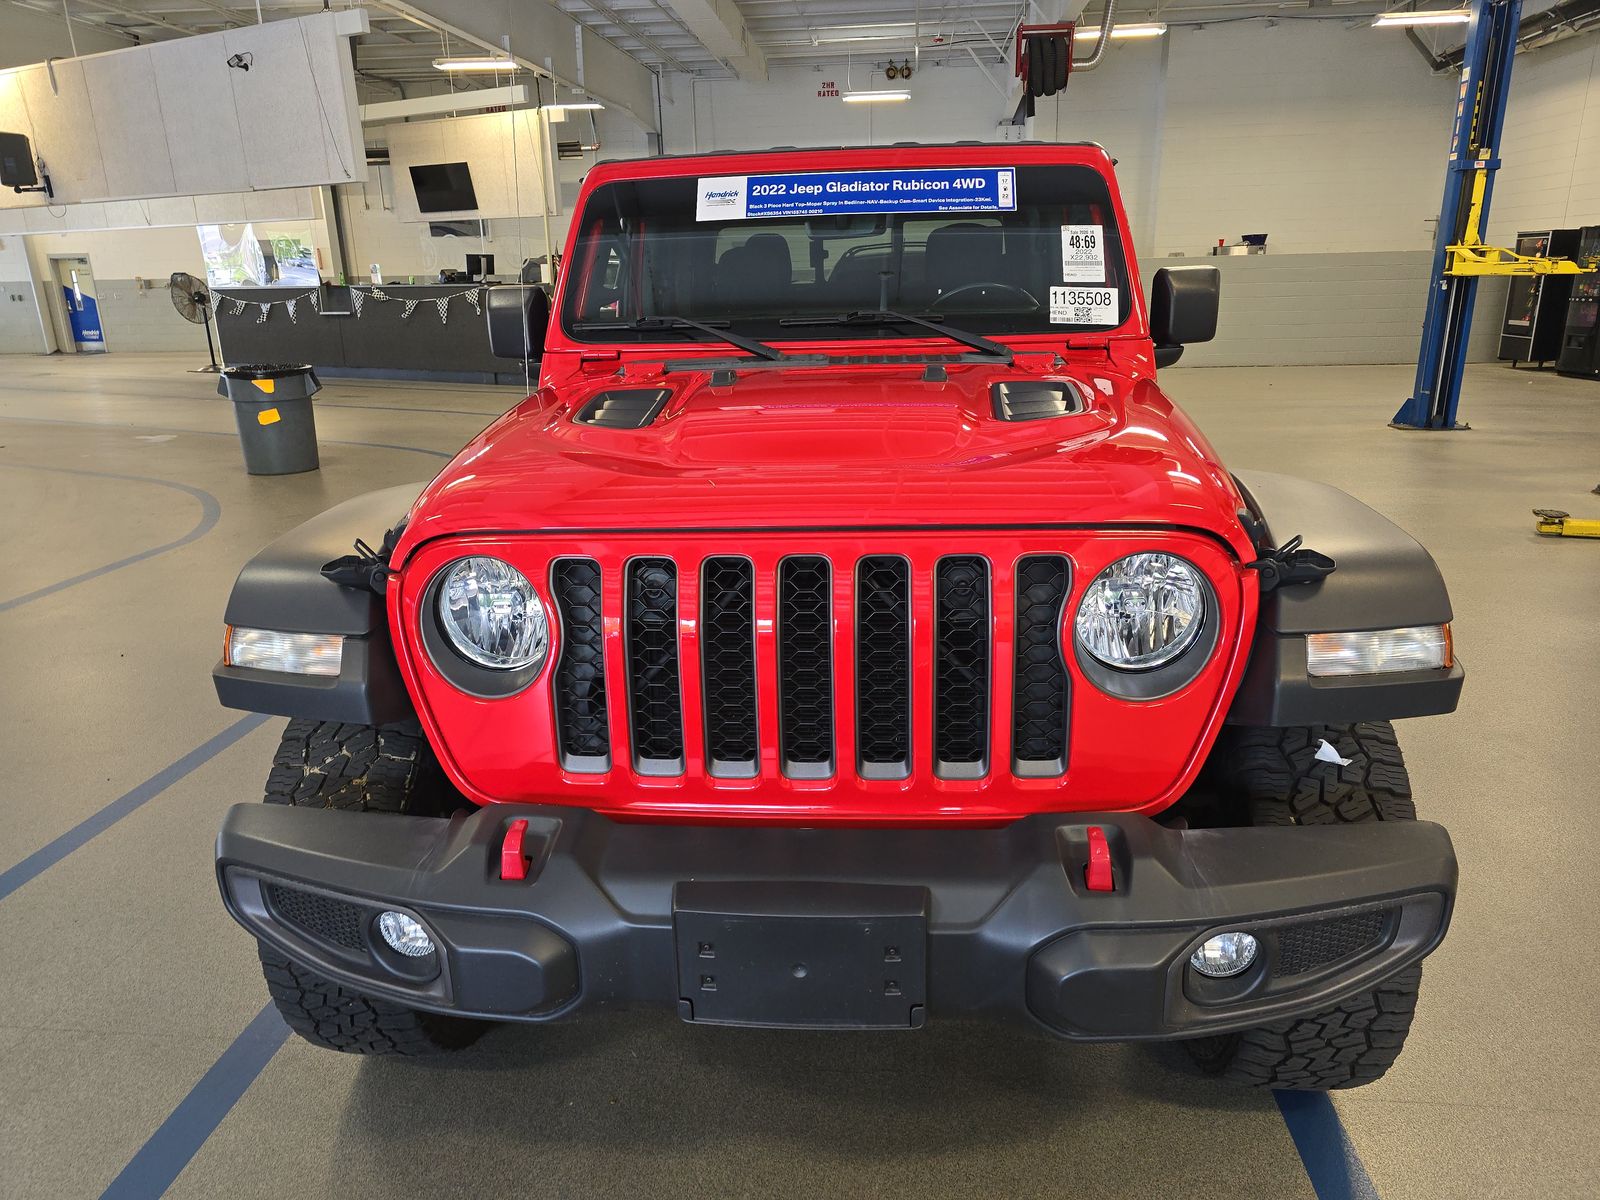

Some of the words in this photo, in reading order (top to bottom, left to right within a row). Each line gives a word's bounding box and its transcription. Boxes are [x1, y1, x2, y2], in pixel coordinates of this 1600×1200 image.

[817, 89, 840, 97] RATED
[752, 184, 786, 196] 2022
[789, 182, 823, 196] Jeep
[826, 180, 889, 194] Gladiator
[892, 178, 950, 191] Rubicon
[952, 178, 986, 189] 4WD
[704, 190, 740, 201] Hendrick
[1069, 235, 1096, 249] 48:69
[1051, 290, 1112, 306] 1135508
